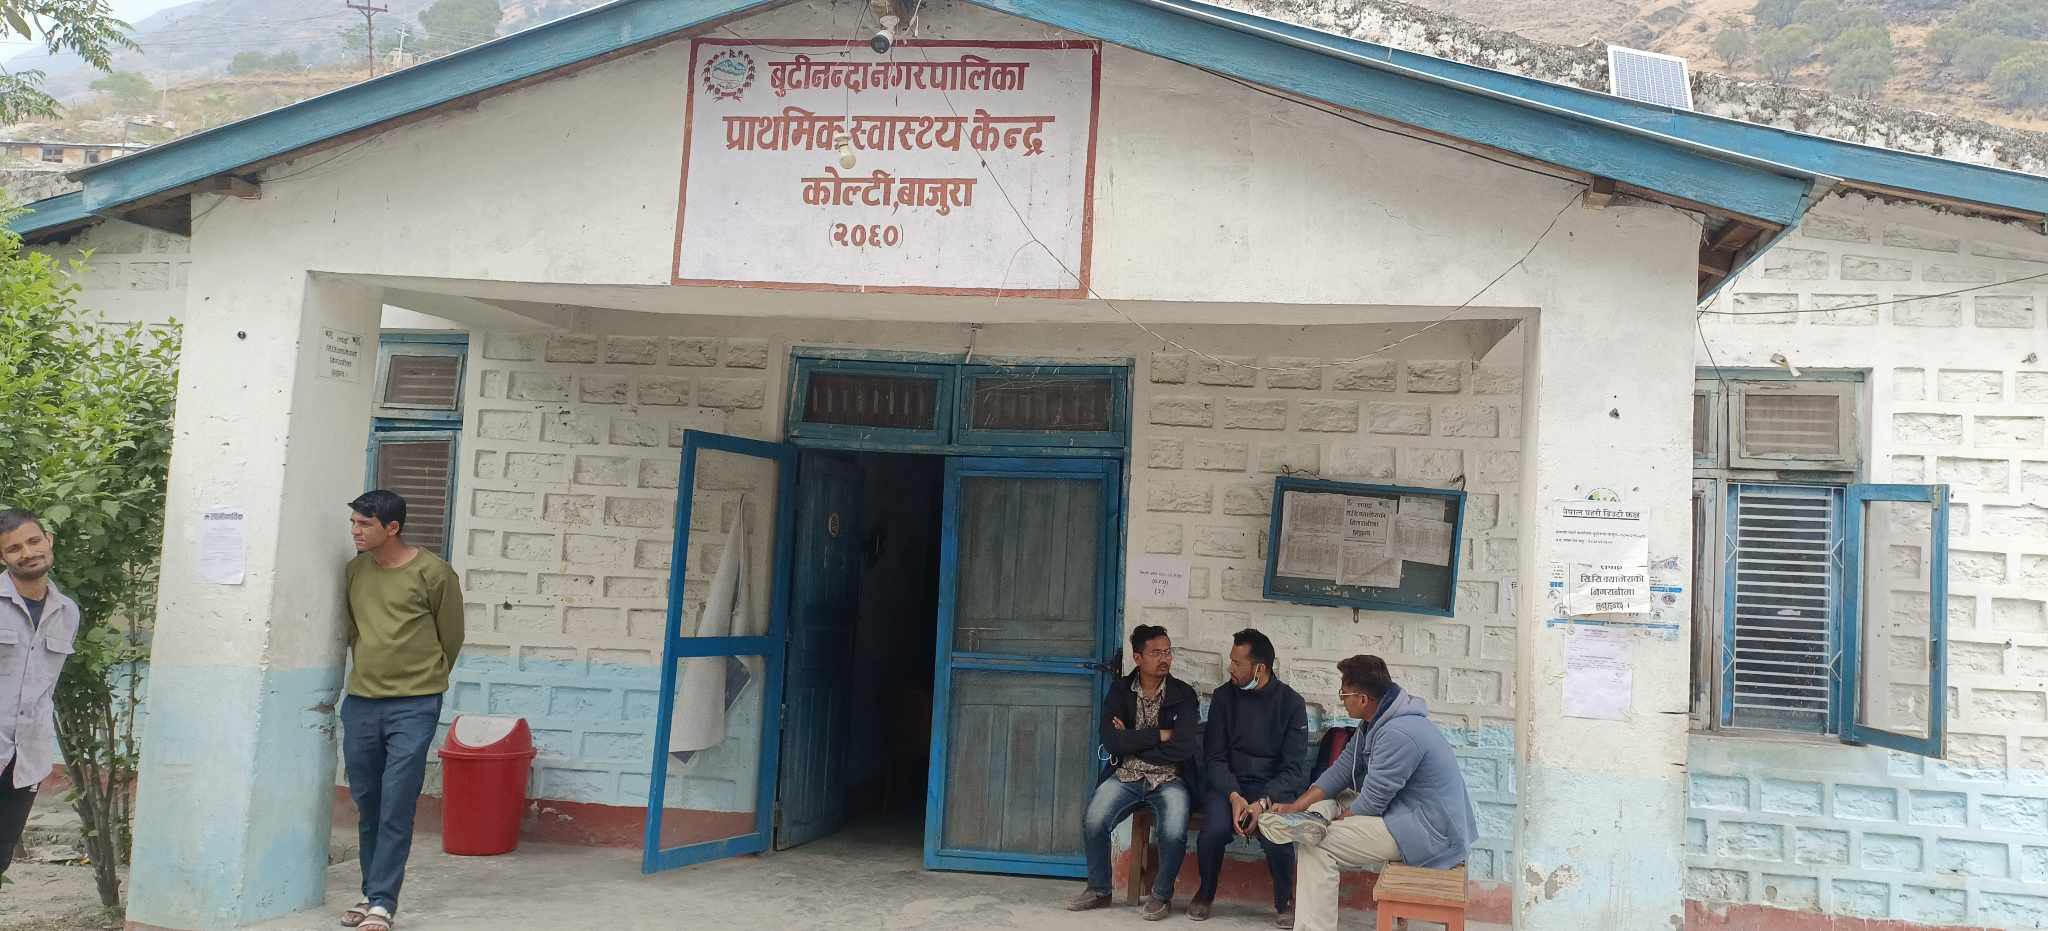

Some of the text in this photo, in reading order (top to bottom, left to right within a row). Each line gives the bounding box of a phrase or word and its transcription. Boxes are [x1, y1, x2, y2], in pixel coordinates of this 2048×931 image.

[870, 54, 1030, 91] नगरपालिका
[722, 106, 1056, 156] प्राथमिक स्वास्थ्य केन्द्र
[828, 223, 904, 248] (२०६०)
